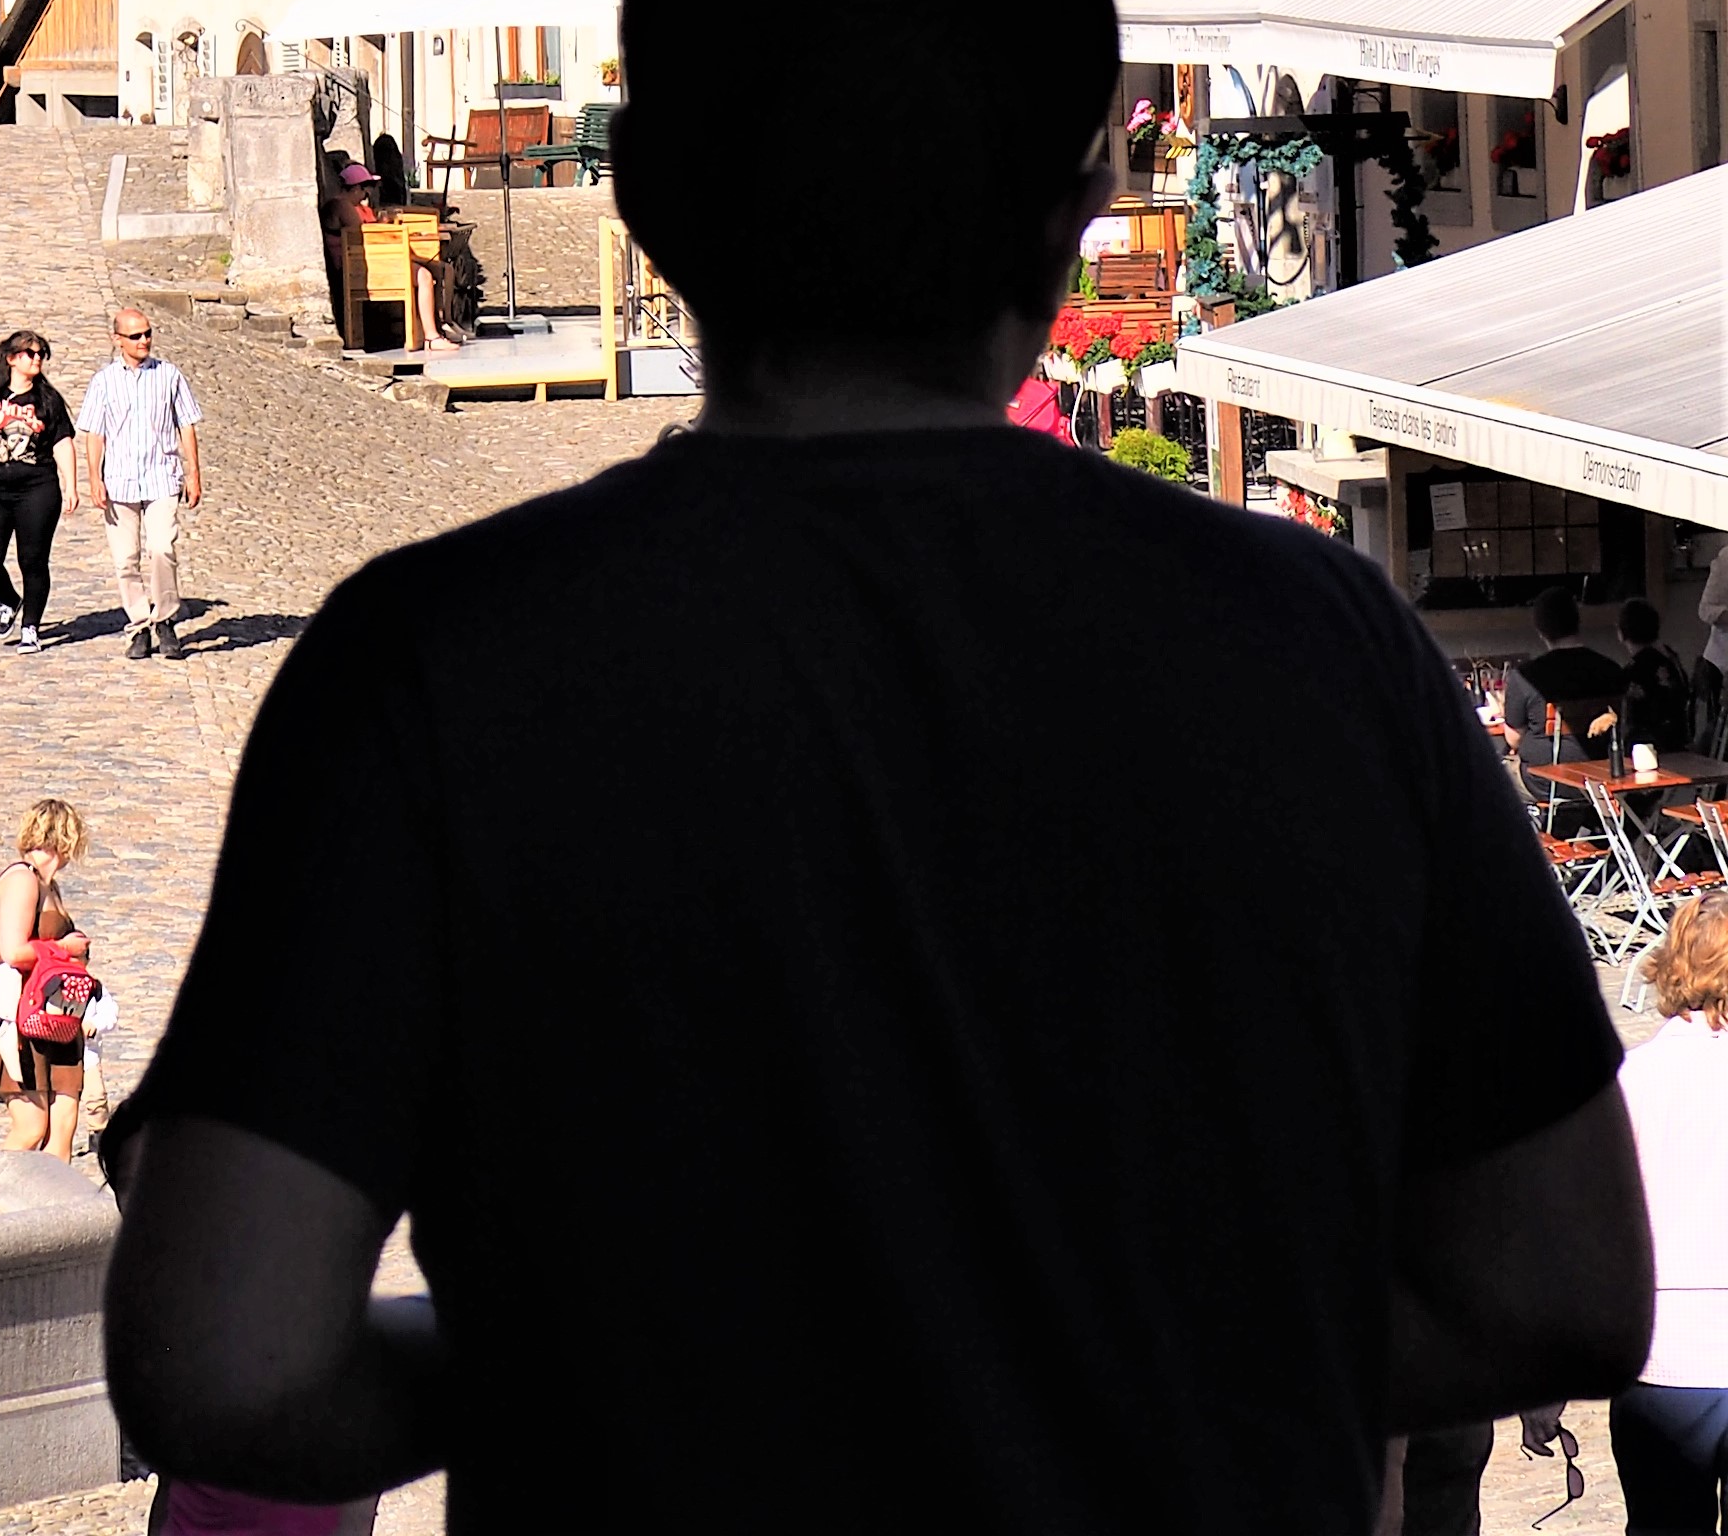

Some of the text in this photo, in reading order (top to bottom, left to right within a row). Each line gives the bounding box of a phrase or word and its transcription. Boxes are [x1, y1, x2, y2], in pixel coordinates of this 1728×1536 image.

[1359, 38, 1441, 81] Hôtel Le Saint Georges
[1401, 408, 1420, 437] dans
[1421, 411, 1432, 440] les
[1433, 414, 1457, 448] jardins
[1583, 451, 1641, 492] Démonstration
